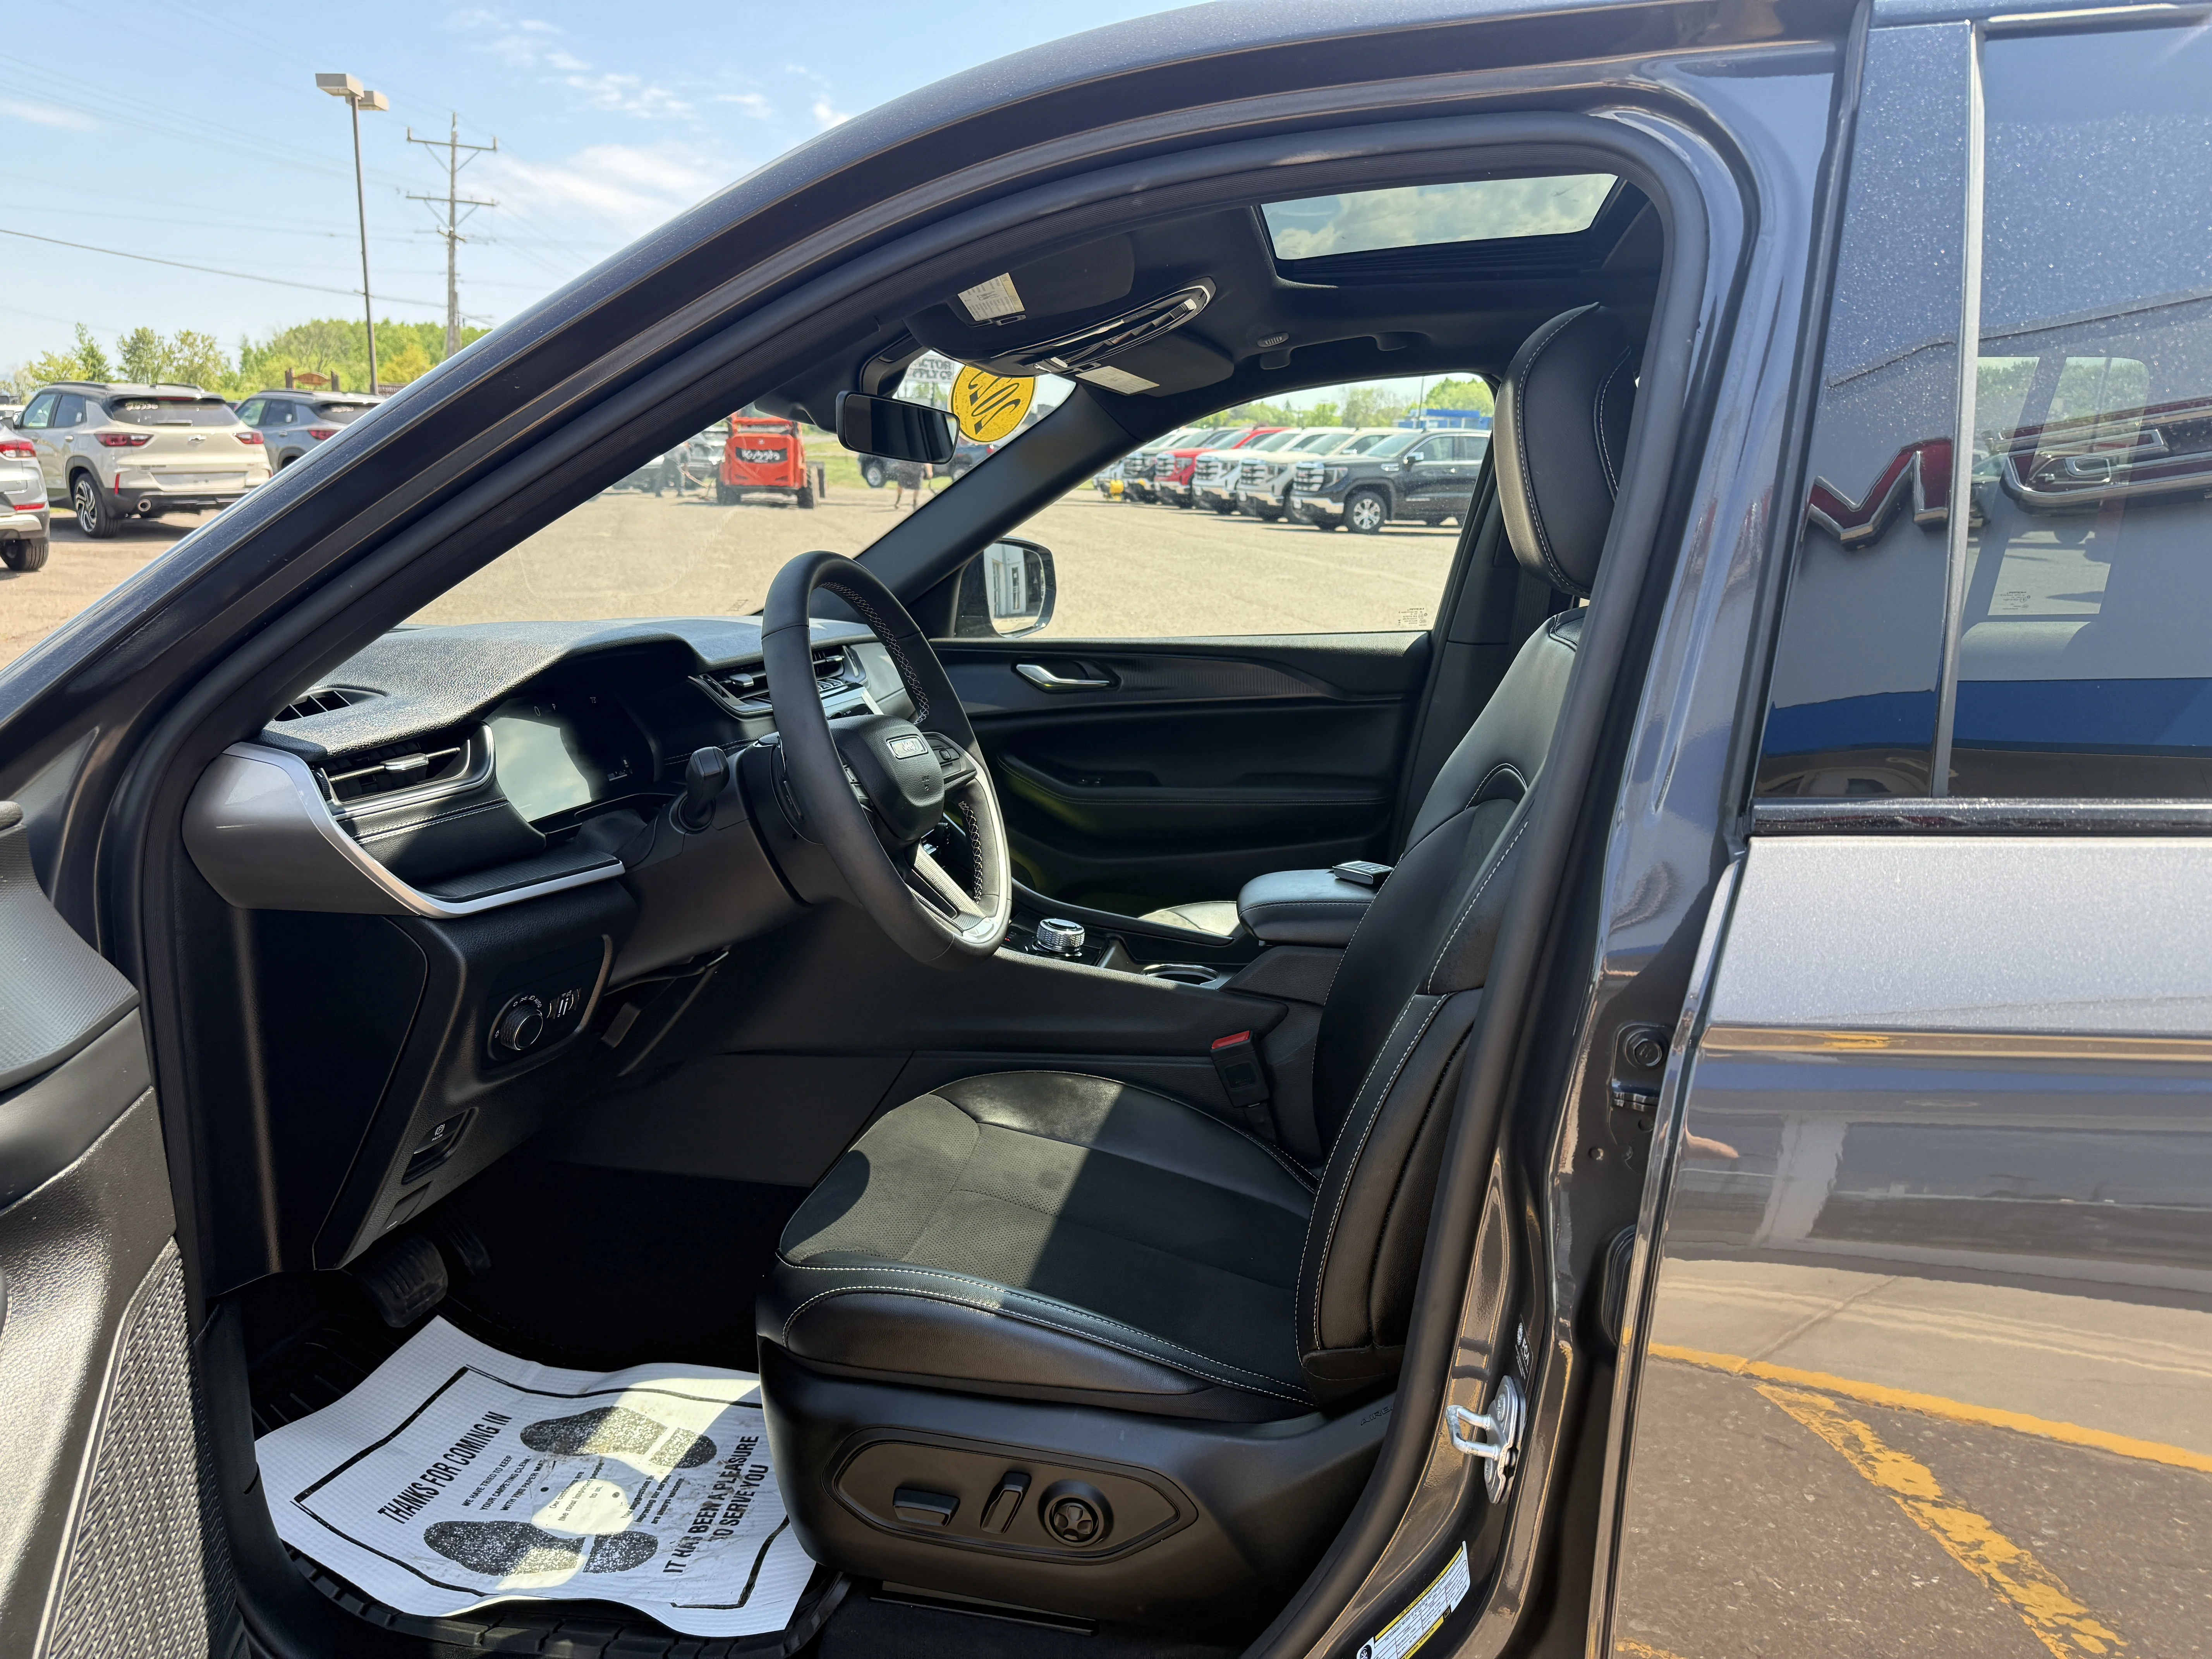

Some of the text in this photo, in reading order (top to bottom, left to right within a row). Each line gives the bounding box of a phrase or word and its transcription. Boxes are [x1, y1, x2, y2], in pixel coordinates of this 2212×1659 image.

[377, 1411, 513, 1524] THANKS FOR COMING IN
[461, 1498, 474, 1506] WE
[469, 1486, 485, 1499] HAVE
[480, 1474, 497, 1486] TRIED
[499, 1455, 512, 1468] KEEP
[479, 1498, 497, 1510] YOUR
[492, 1473, 519, 1497] CARPETING
[500, 1498, 517, 1511] WITH
[521, 1473, 539, 1488] PAPER
[558, 1512, 569, 1521] the
[663, 1436, 759, 1573] IT HAS BEEN A PLEASURE
[719, 1490, 756, 1526] SERVE
[740, 1464, 769, 1487] YOU
